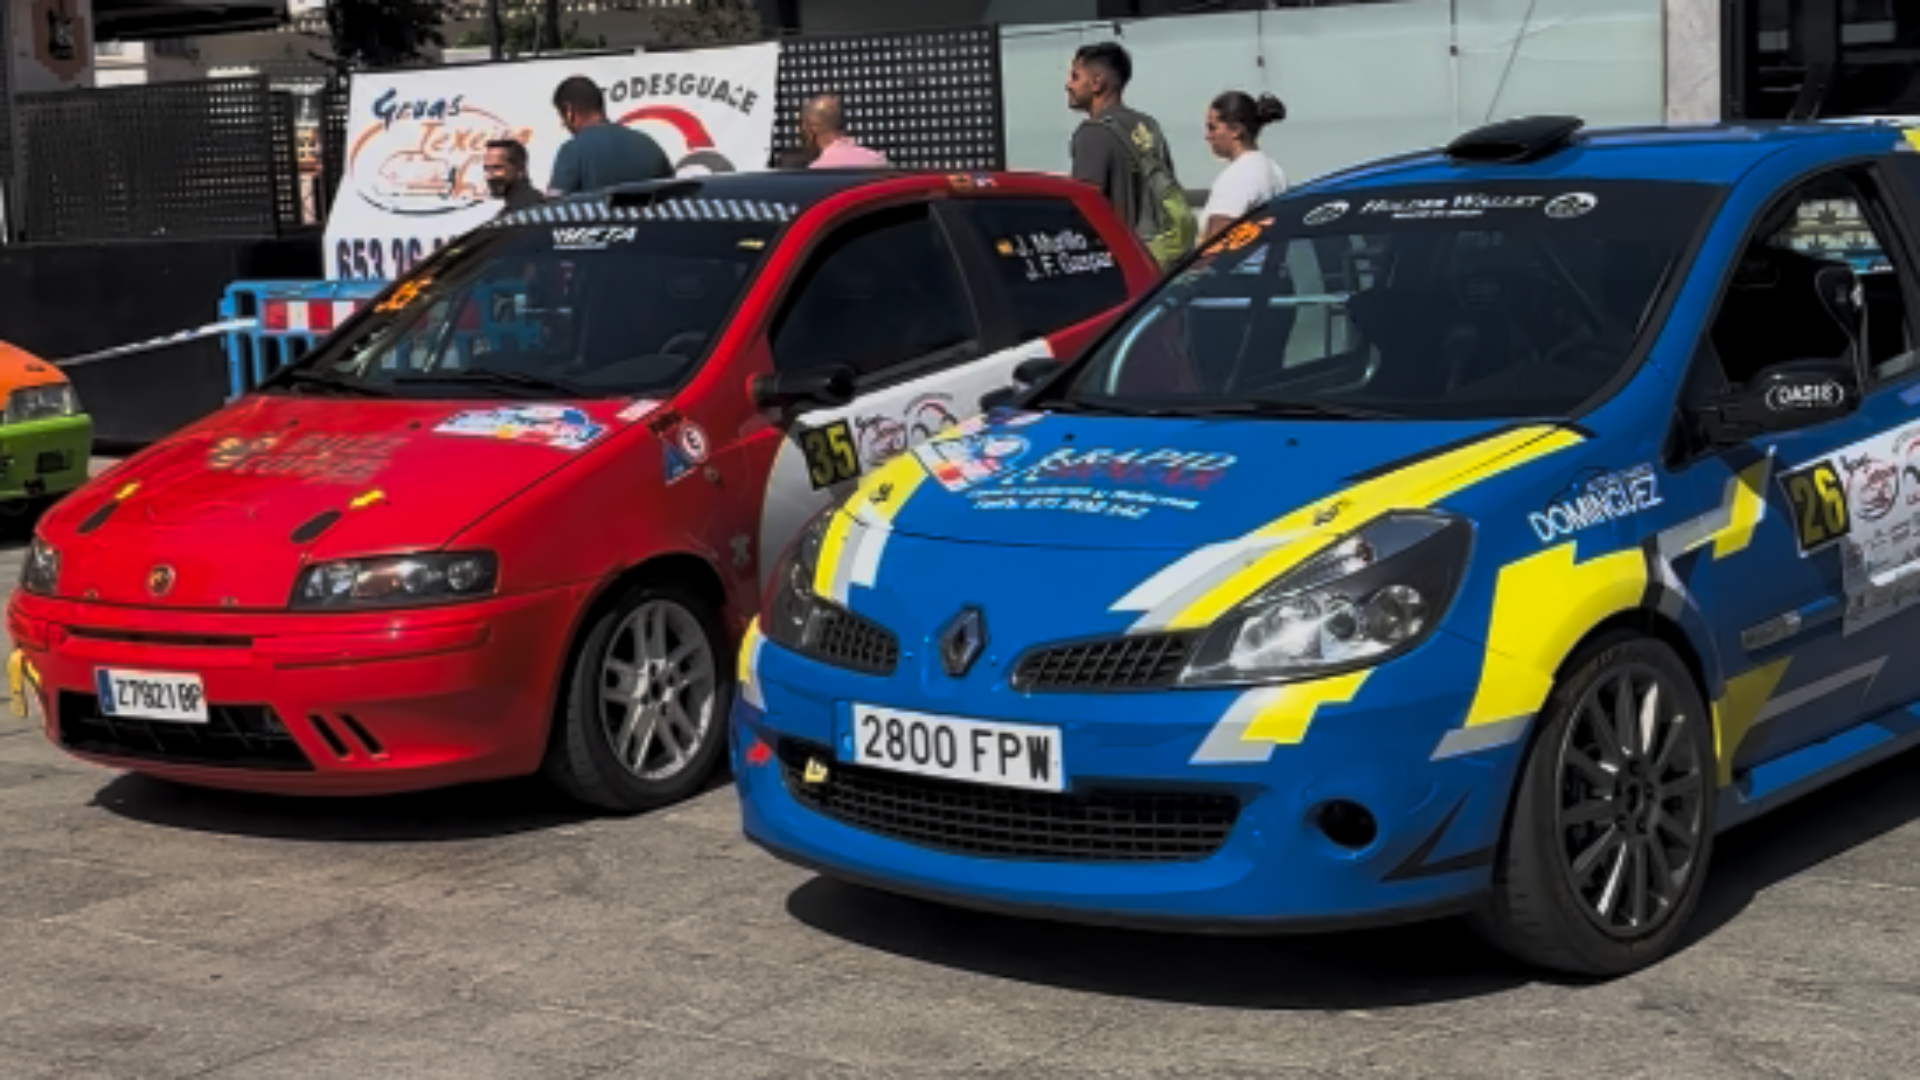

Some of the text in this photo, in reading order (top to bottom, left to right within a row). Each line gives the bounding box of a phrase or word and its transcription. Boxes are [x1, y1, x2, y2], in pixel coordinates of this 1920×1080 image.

[373, 88, 464, 131] Gruas
[336, 237, 386, 281] 653
[804, 422, 858, 485] 35
[1789, 466, 1846, 546] 26
[861, 714, 1051, 783] 2800 FPW
